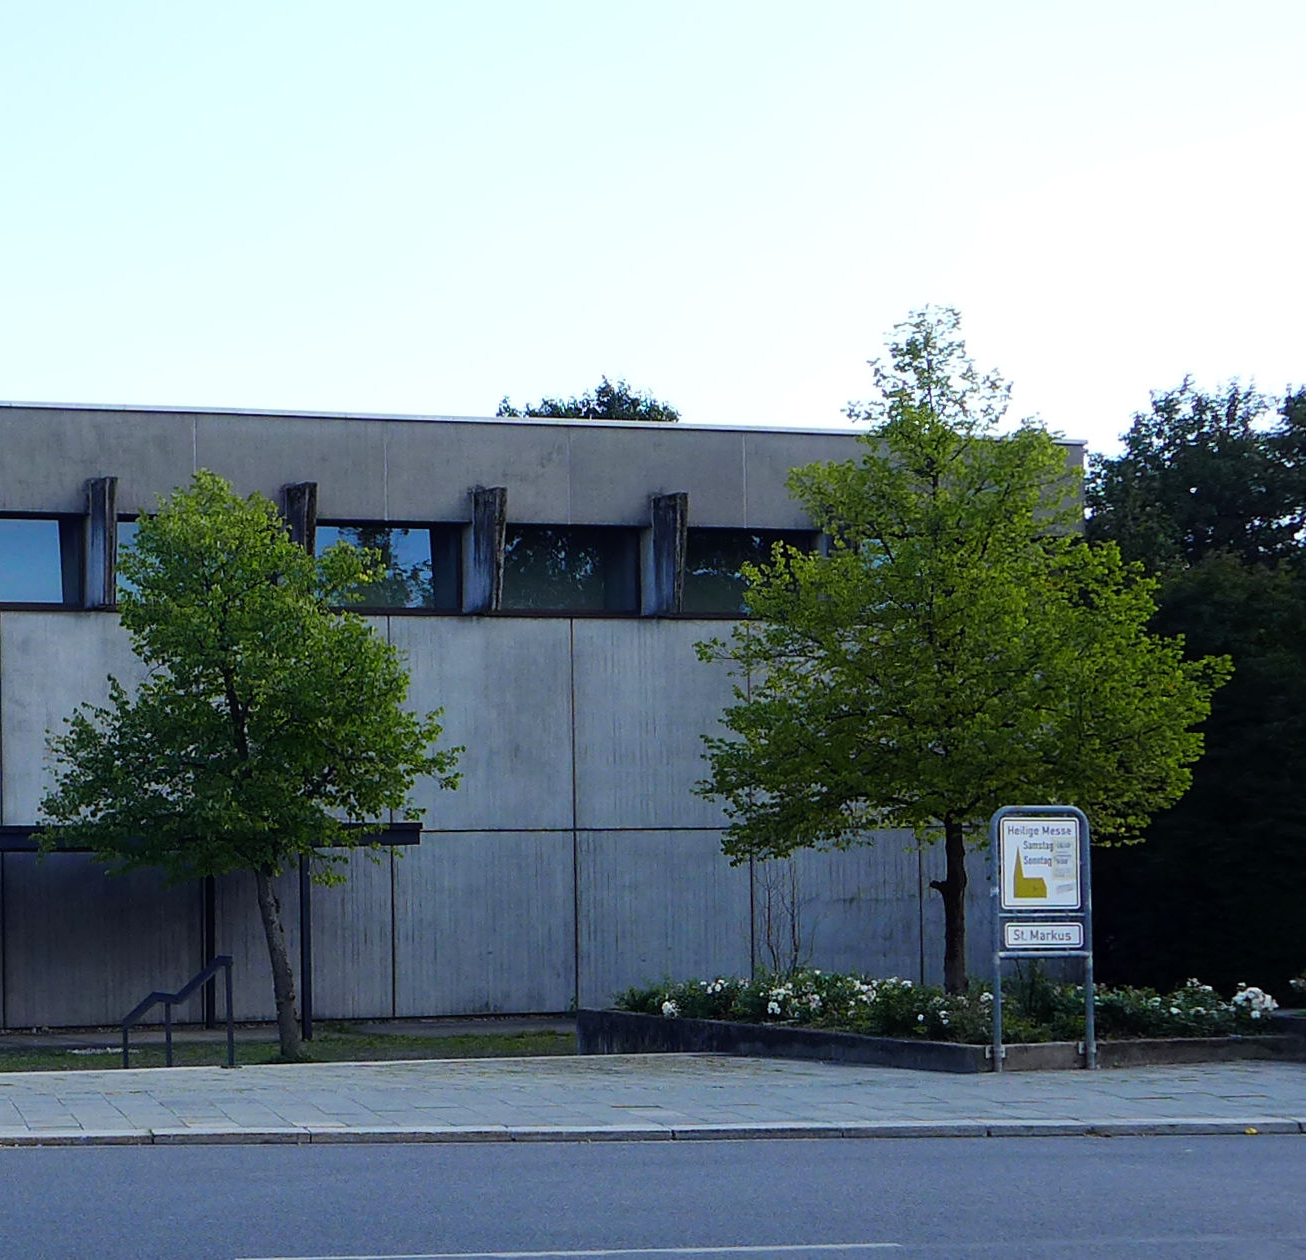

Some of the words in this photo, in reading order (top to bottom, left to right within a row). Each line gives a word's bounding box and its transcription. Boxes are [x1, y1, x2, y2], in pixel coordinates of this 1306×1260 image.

[1007, 825, 1039, 838] Heilige
[1042, 826, 1072, 836] Messe
[1023, 840, 1054, 852] Samstag
[1023, 855, 1052, 867] Sonntag
[1013, 929, 1027, 940] St.
[1030, 930, 1072, 941] Markus
